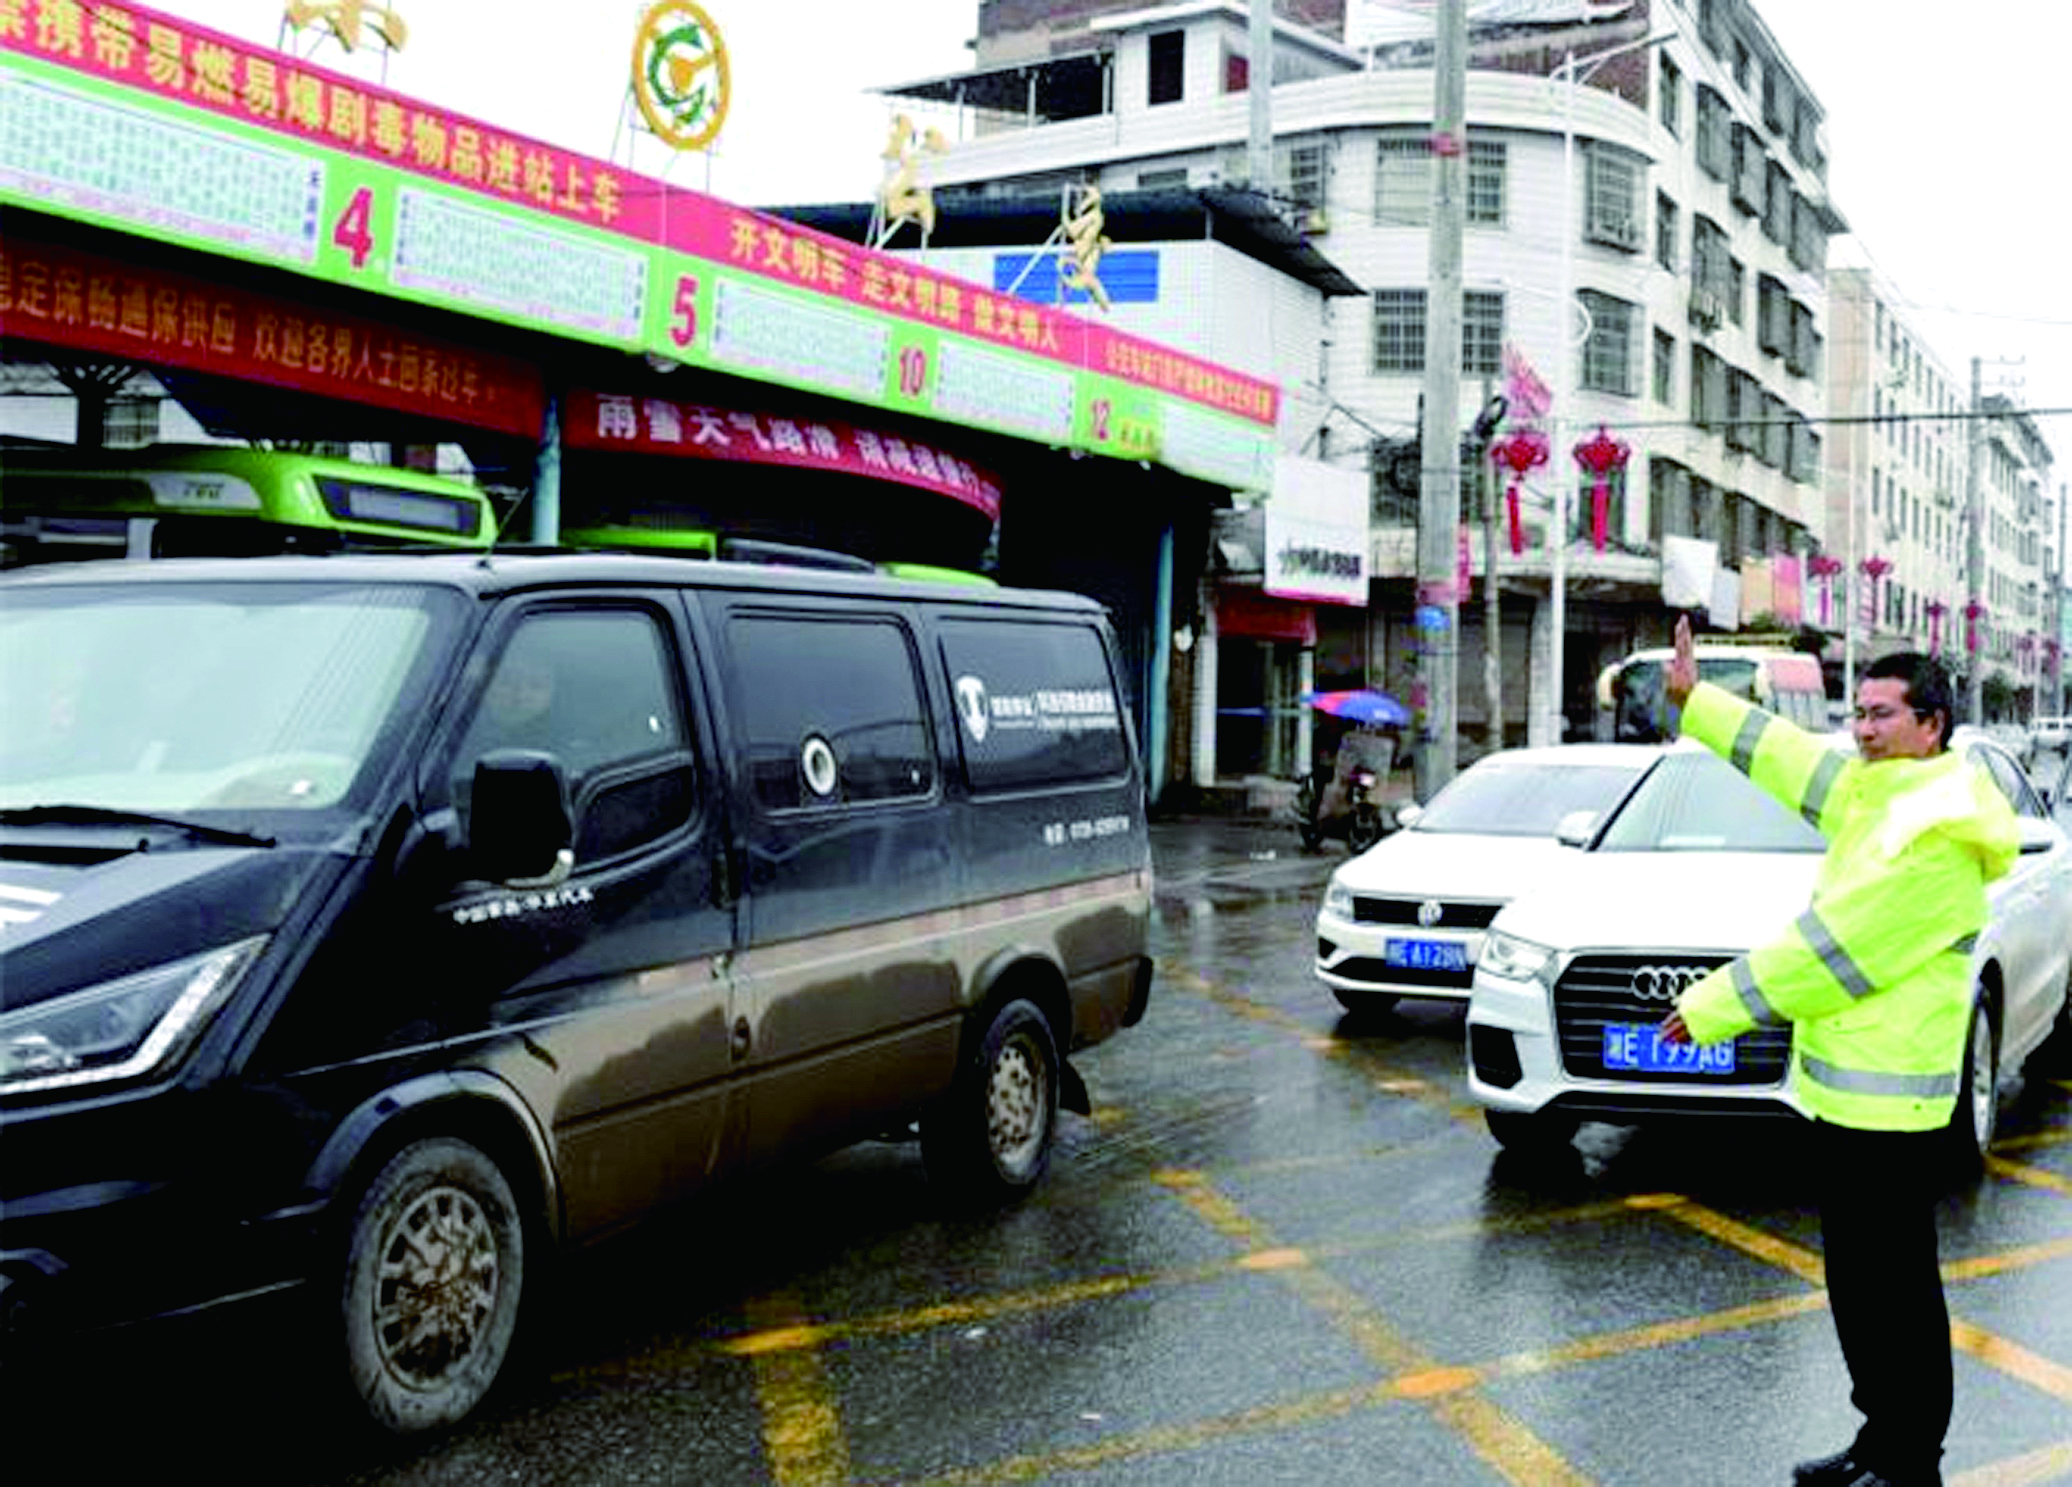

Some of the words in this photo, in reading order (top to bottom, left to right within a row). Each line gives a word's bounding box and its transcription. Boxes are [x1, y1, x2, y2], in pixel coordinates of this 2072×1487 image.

[333, 187, 373, 268] 4
[669, 275, 699, 347] 5
[899, 348, 927, 397] 10
